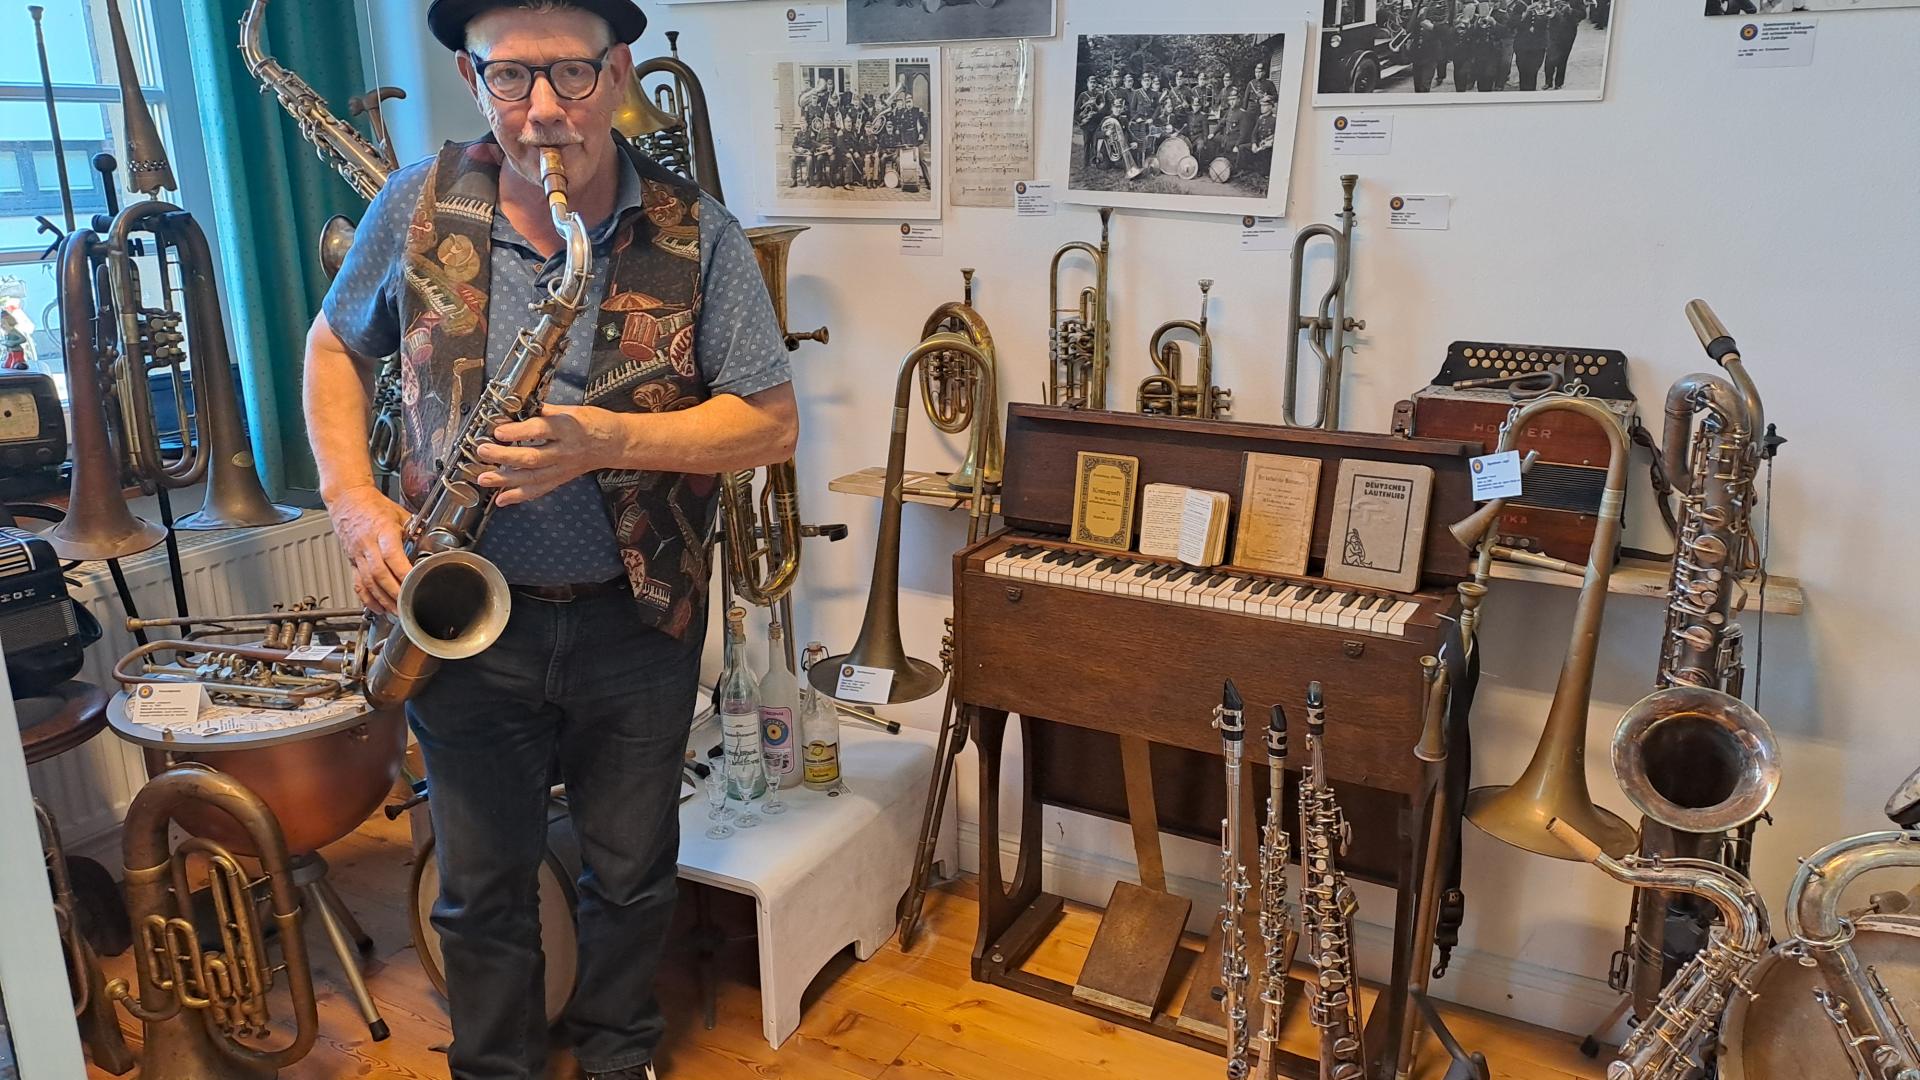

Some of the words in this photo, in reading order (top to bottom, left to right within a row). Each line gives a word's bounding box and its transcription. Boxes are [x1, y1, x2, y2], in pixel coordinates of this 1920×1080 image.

[1474, 423, 1552, 439] HOER
[1365, 481, 1406, 492] DEUTSCHES
[1364, 489, 1405, 500] LAUTENLIED
